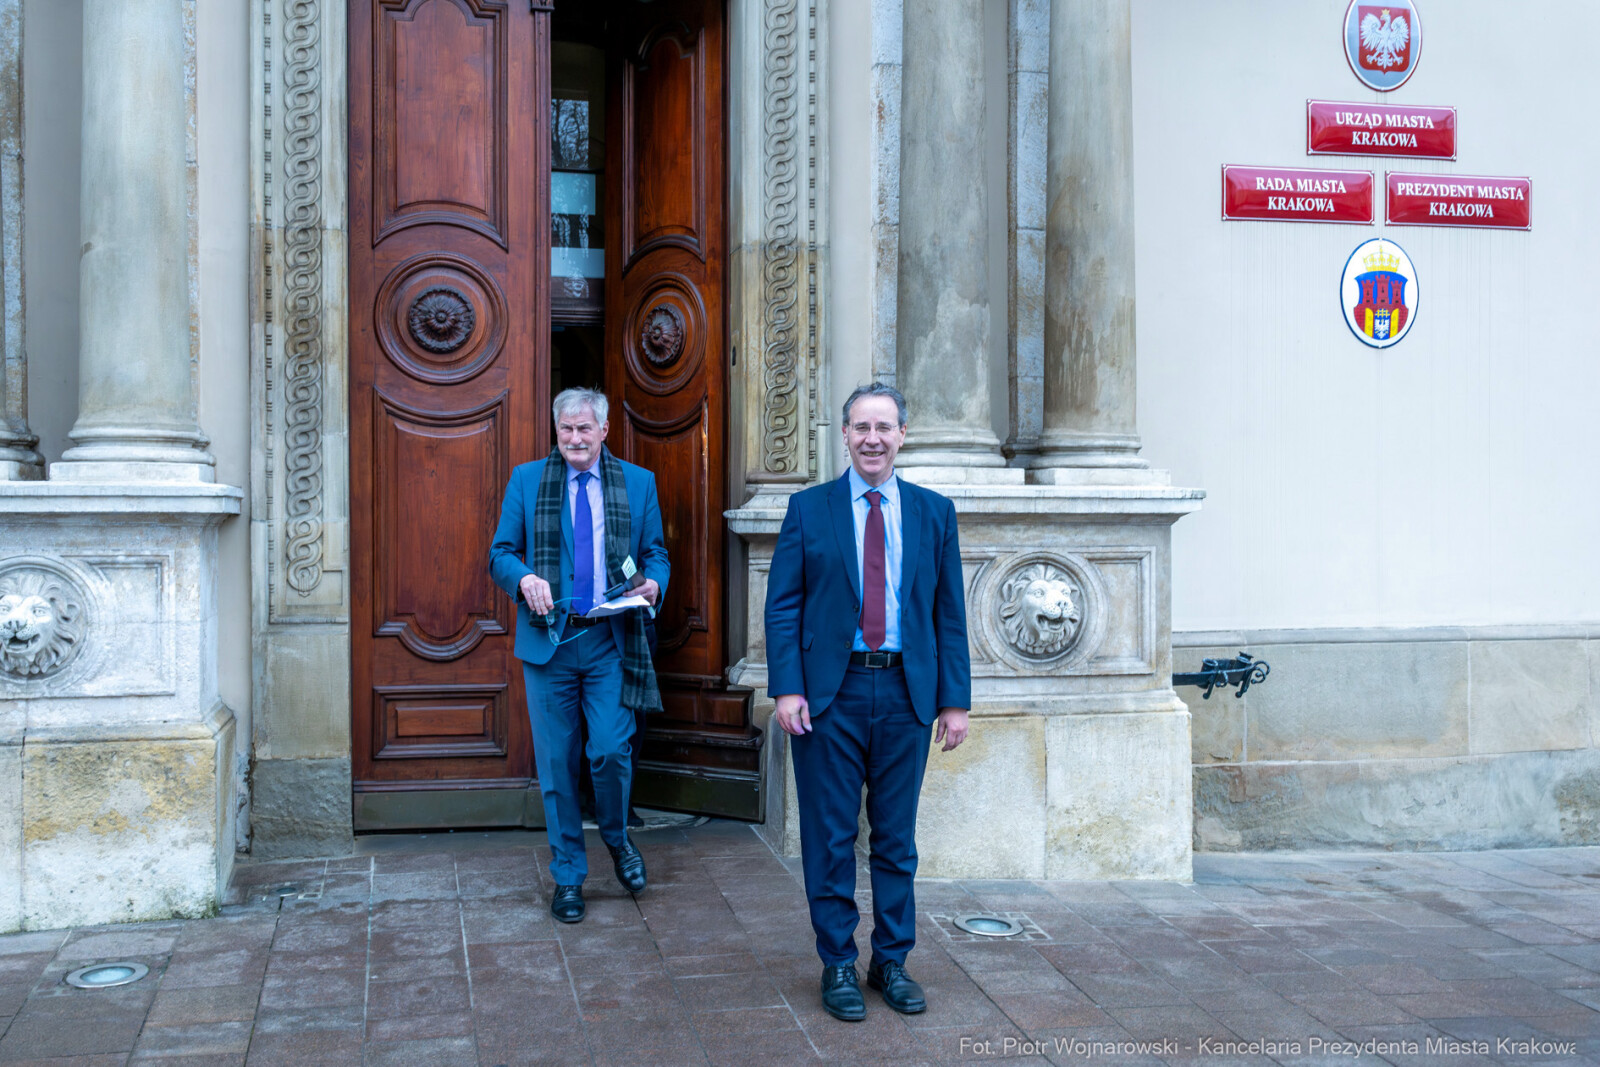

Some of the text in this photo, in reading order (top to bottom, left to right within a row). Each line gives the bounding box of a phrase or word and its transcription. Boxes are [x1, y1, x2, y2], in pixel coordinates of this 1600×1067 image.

[1335, 112, 1434, 129] URZĄD MIASTA
[1351, 131, 1418, 147] KRAKOWA
[1255, 177, 1347, 193] RADA MIASTA
[1396, 182, 1524, 200] PREZYDENT MIASTA
[1267, 196, 1335, 212] KRAKOWA
[1429, 202, 1494, 218] KRAKOWA
